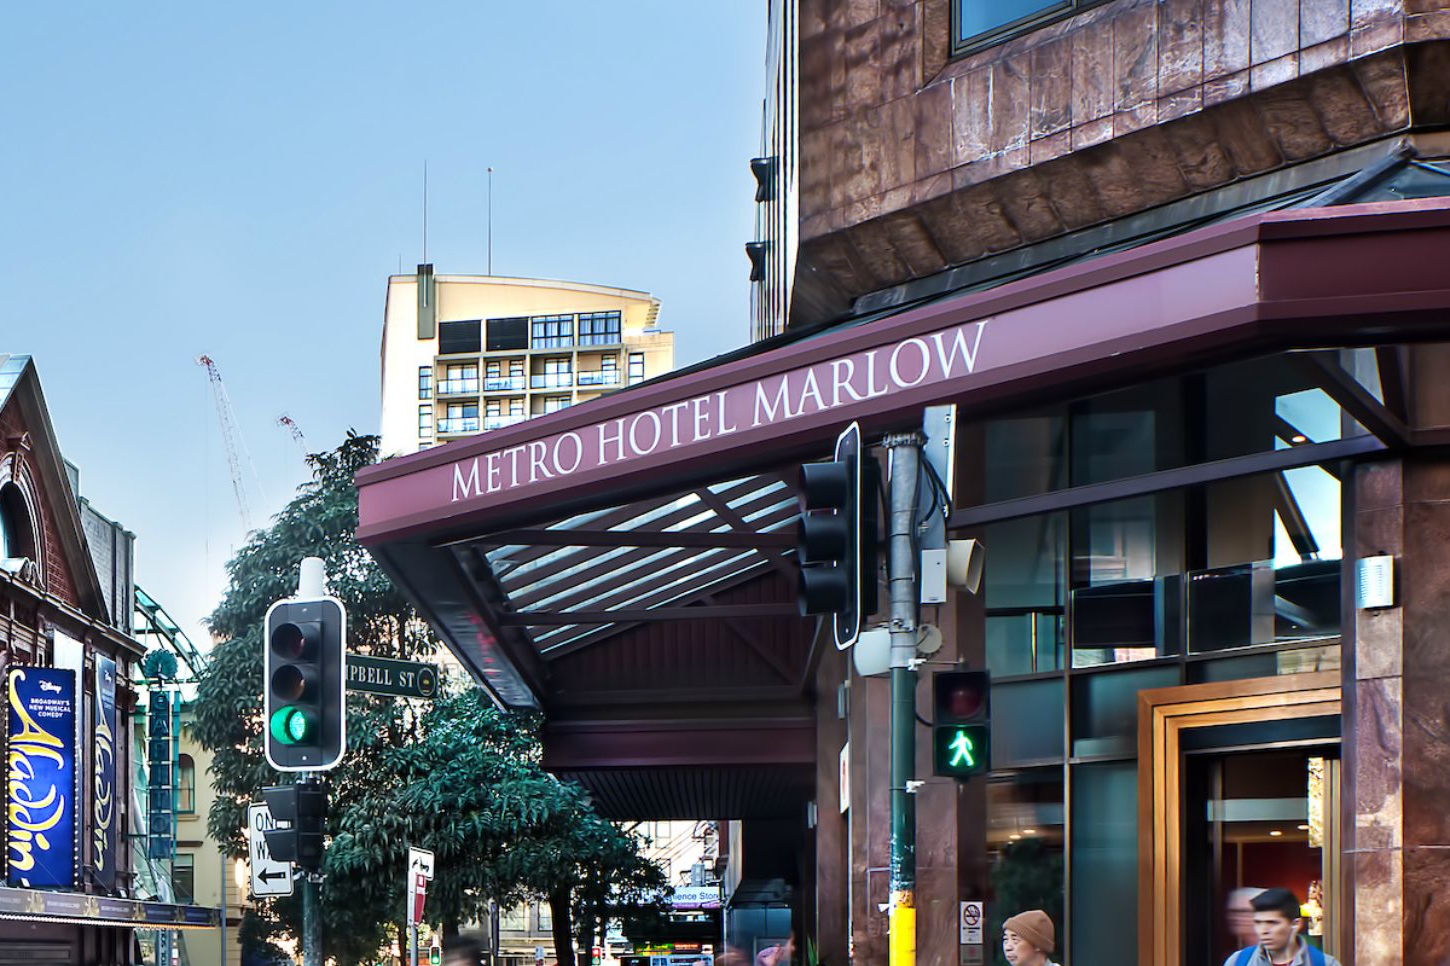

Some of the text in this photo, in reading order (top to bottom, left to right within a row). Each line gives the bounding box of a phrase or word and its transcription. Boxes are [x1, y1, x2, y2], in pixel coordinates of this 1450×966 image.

[451, 319, 988, 503] METRO HOTEL MARLOW
[38, 679, 63, 695] Disney
[399, 670, 415, 688] ST
[29, 703, 71, 714] NEW MUSICAL
[30, 697, 70, 707] BROADWAY'S
[37, 710, 64, 719] COMEDY
[255, 812, 274, 832] ON
